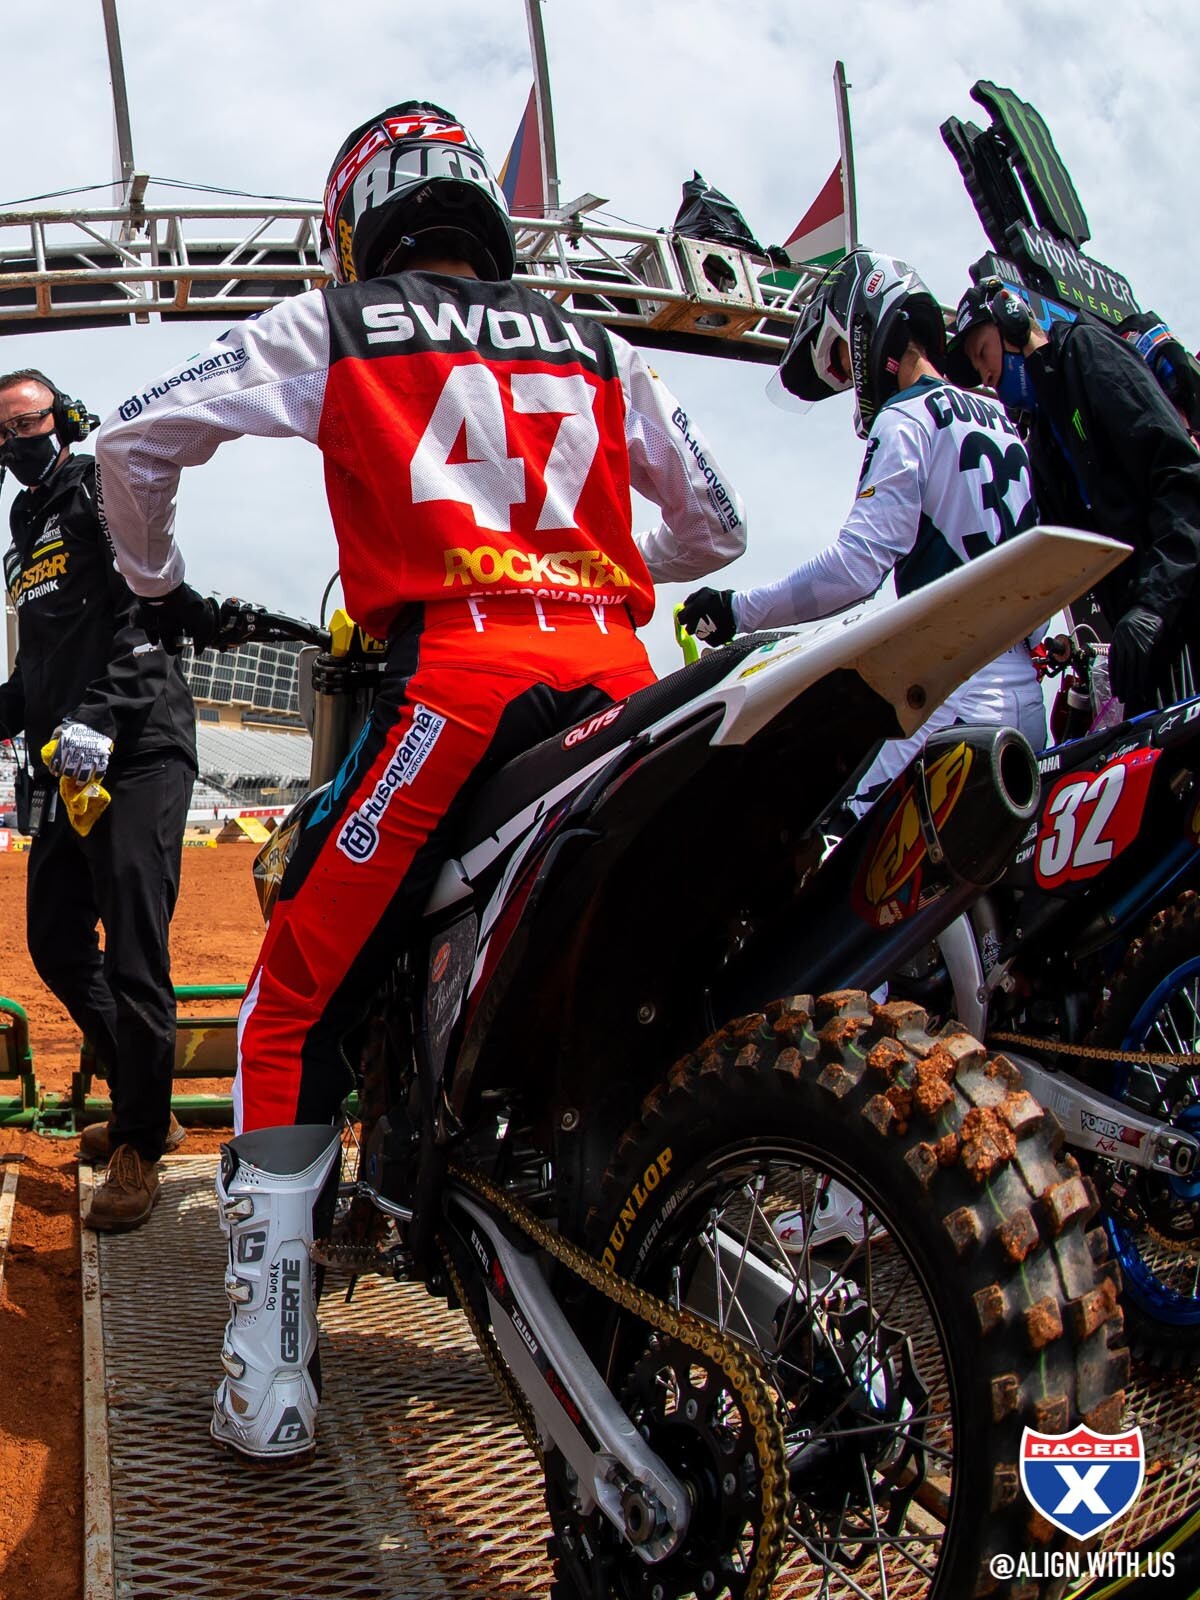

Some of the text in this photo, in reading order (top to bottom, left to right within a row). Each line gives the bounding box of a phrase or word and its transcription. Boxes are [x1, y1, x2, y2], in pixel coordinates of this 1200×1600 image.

[867, 272, 883, 294] BELL
[1021, 227, 1142, 314] MONSTER
[362, 301, 598, 363] SWOLL
[1004, 302, 1020, 315] 32
[142, 347, 249, 405] Husqvarna
[409, 363, 600, 532] 47
[685, 432, 740, 530] Husqvarna
[28, 580, 60, 601] DRINK
[405, 718, 443, 781] FACTORY RACING
[564, 704, 625, 747] GUTS
[361, 707, 434, 826] Husqvarna
[1039, 763, 1126, 877] 32
[1081, 1110, 1125, 1142] VORTEX
[601, 1147, 673, 1273] DUNLOP
[266, 1261, 281, 1311] DO WORK
[280, 1257, 301, 1364] GAERNE
